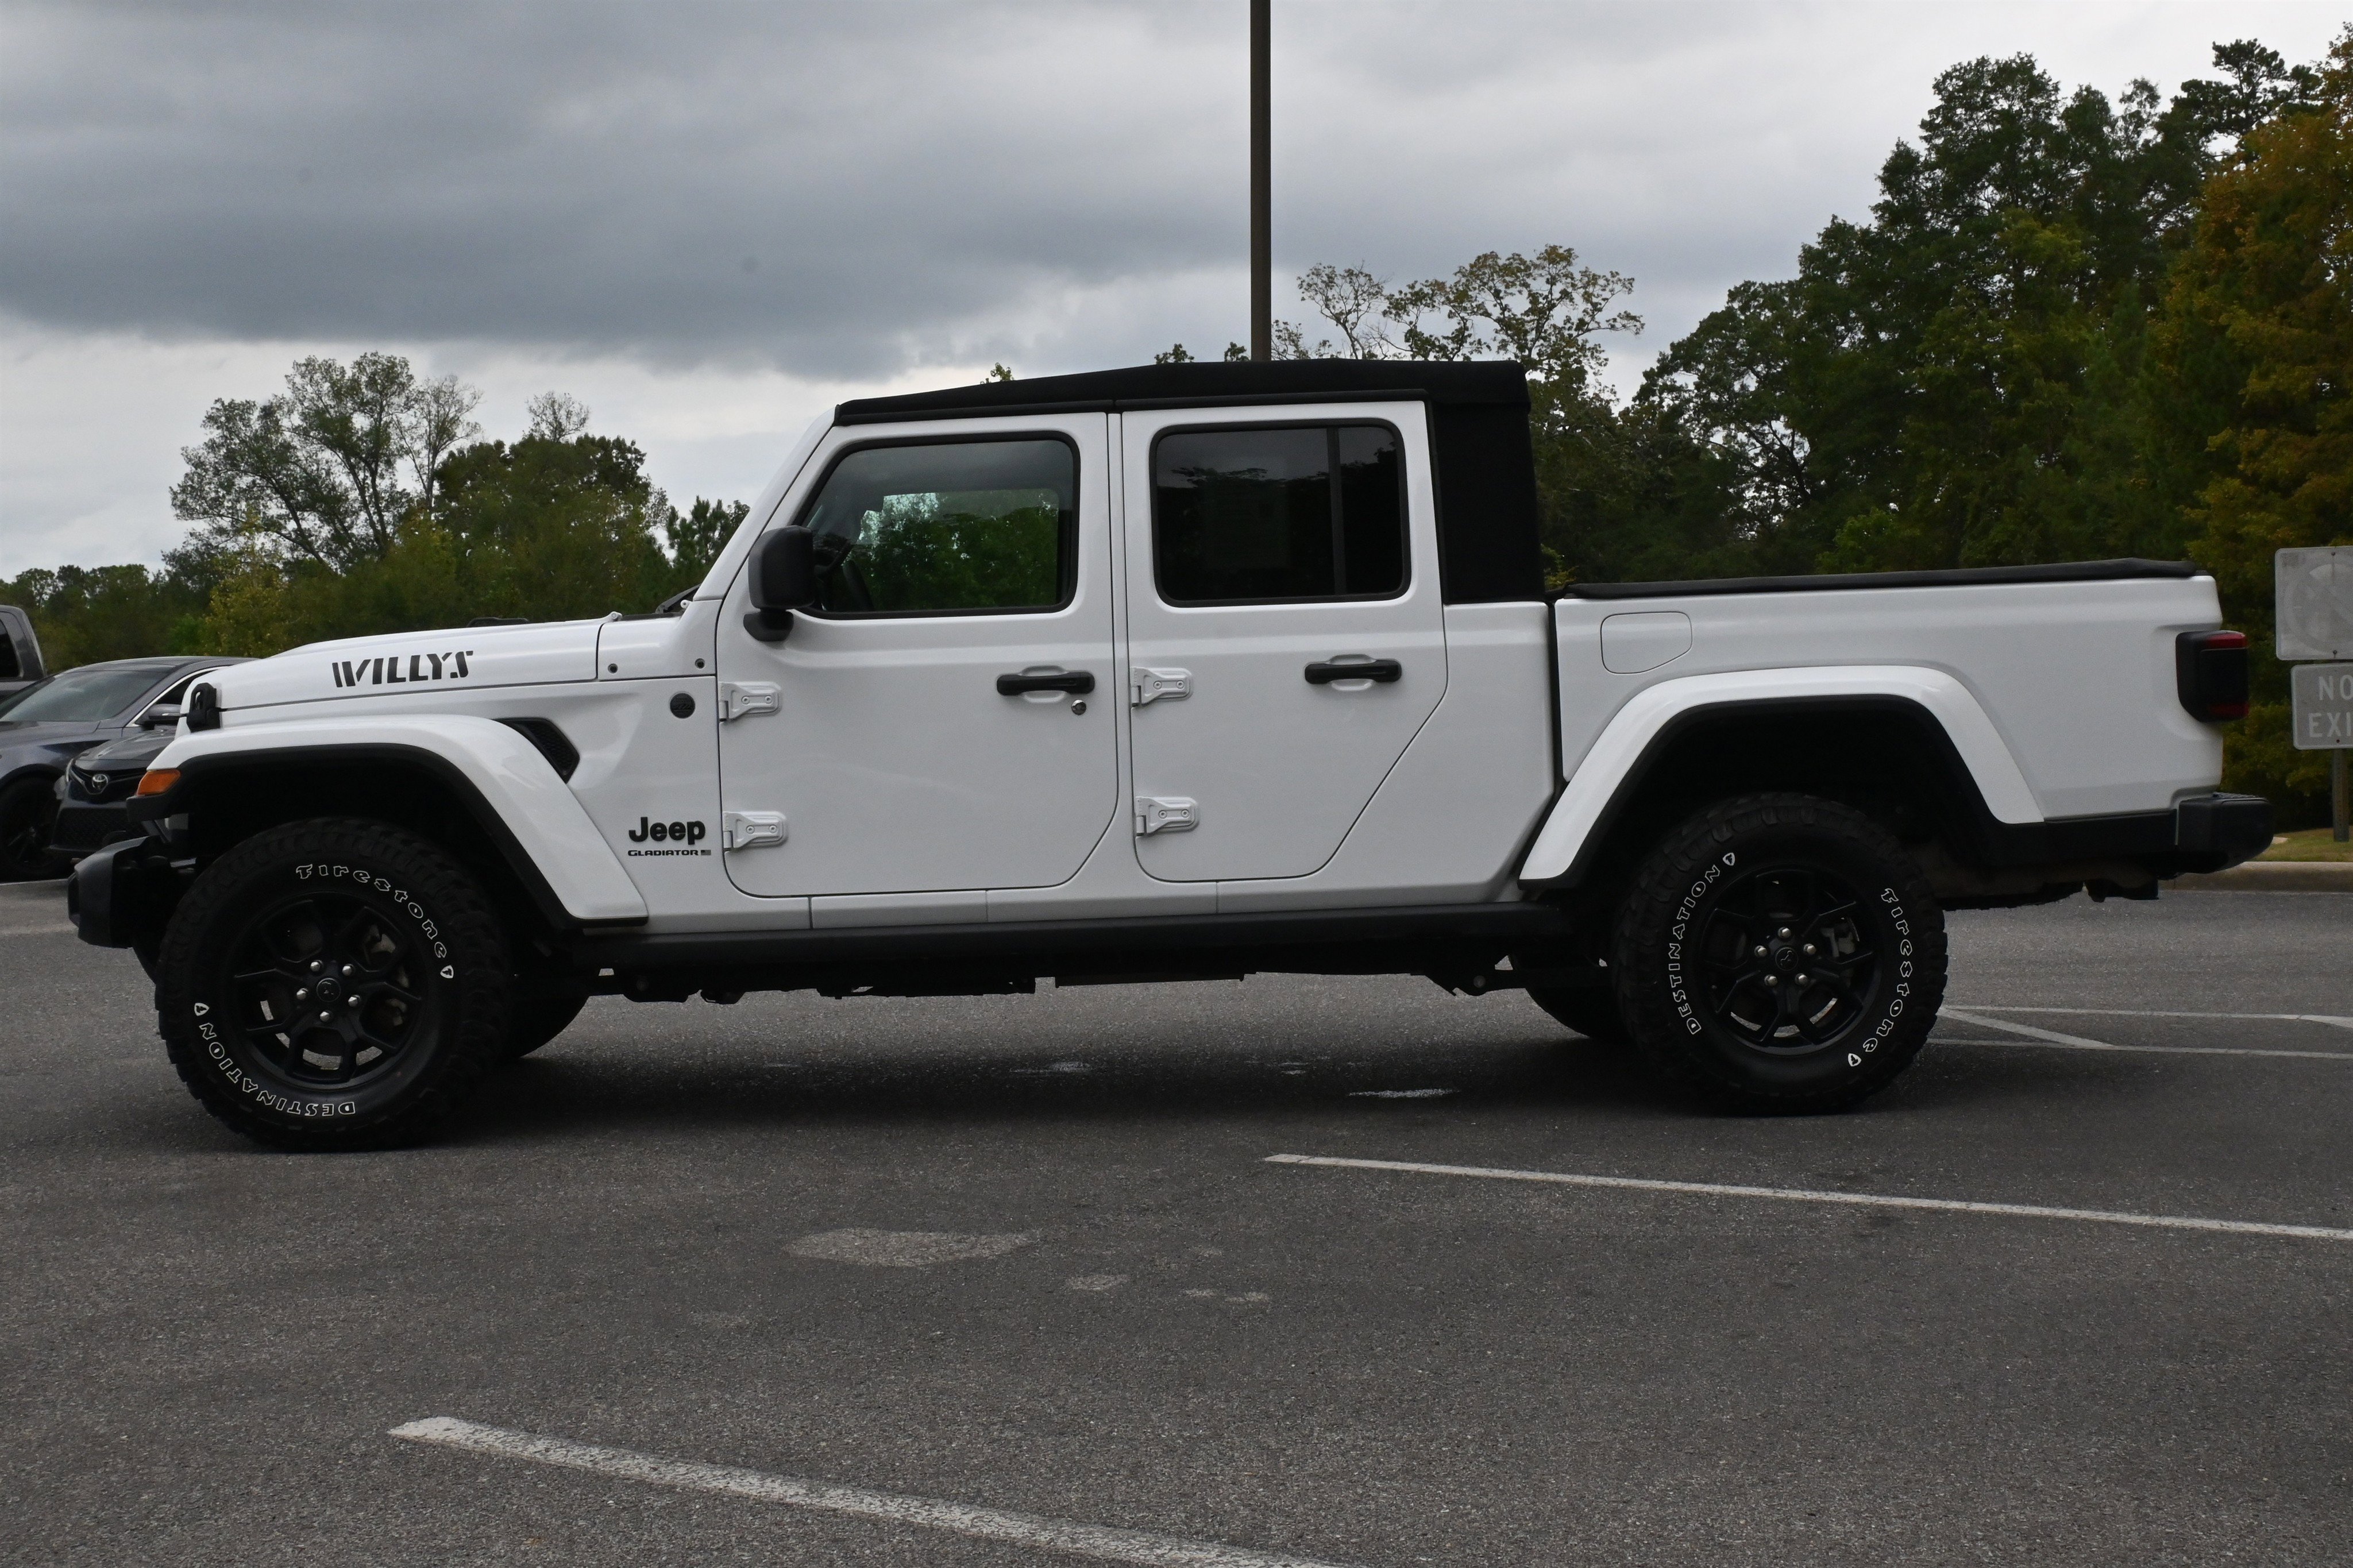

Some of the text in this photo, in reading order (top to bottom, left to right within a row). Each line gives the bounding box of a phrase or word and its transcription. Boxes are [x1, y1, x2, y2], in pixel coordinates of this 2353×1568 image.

[331, 650, 474, 688] WILLYS
[2319, 674, 2353, 700] NO
[2309, 712, 2353, 737] EXI
[628, 816, 705, 845] Jeep
[1668, 864, 1721, 1035] DESTINATION
[198, 1022, 356, 1117] DESTINATION
